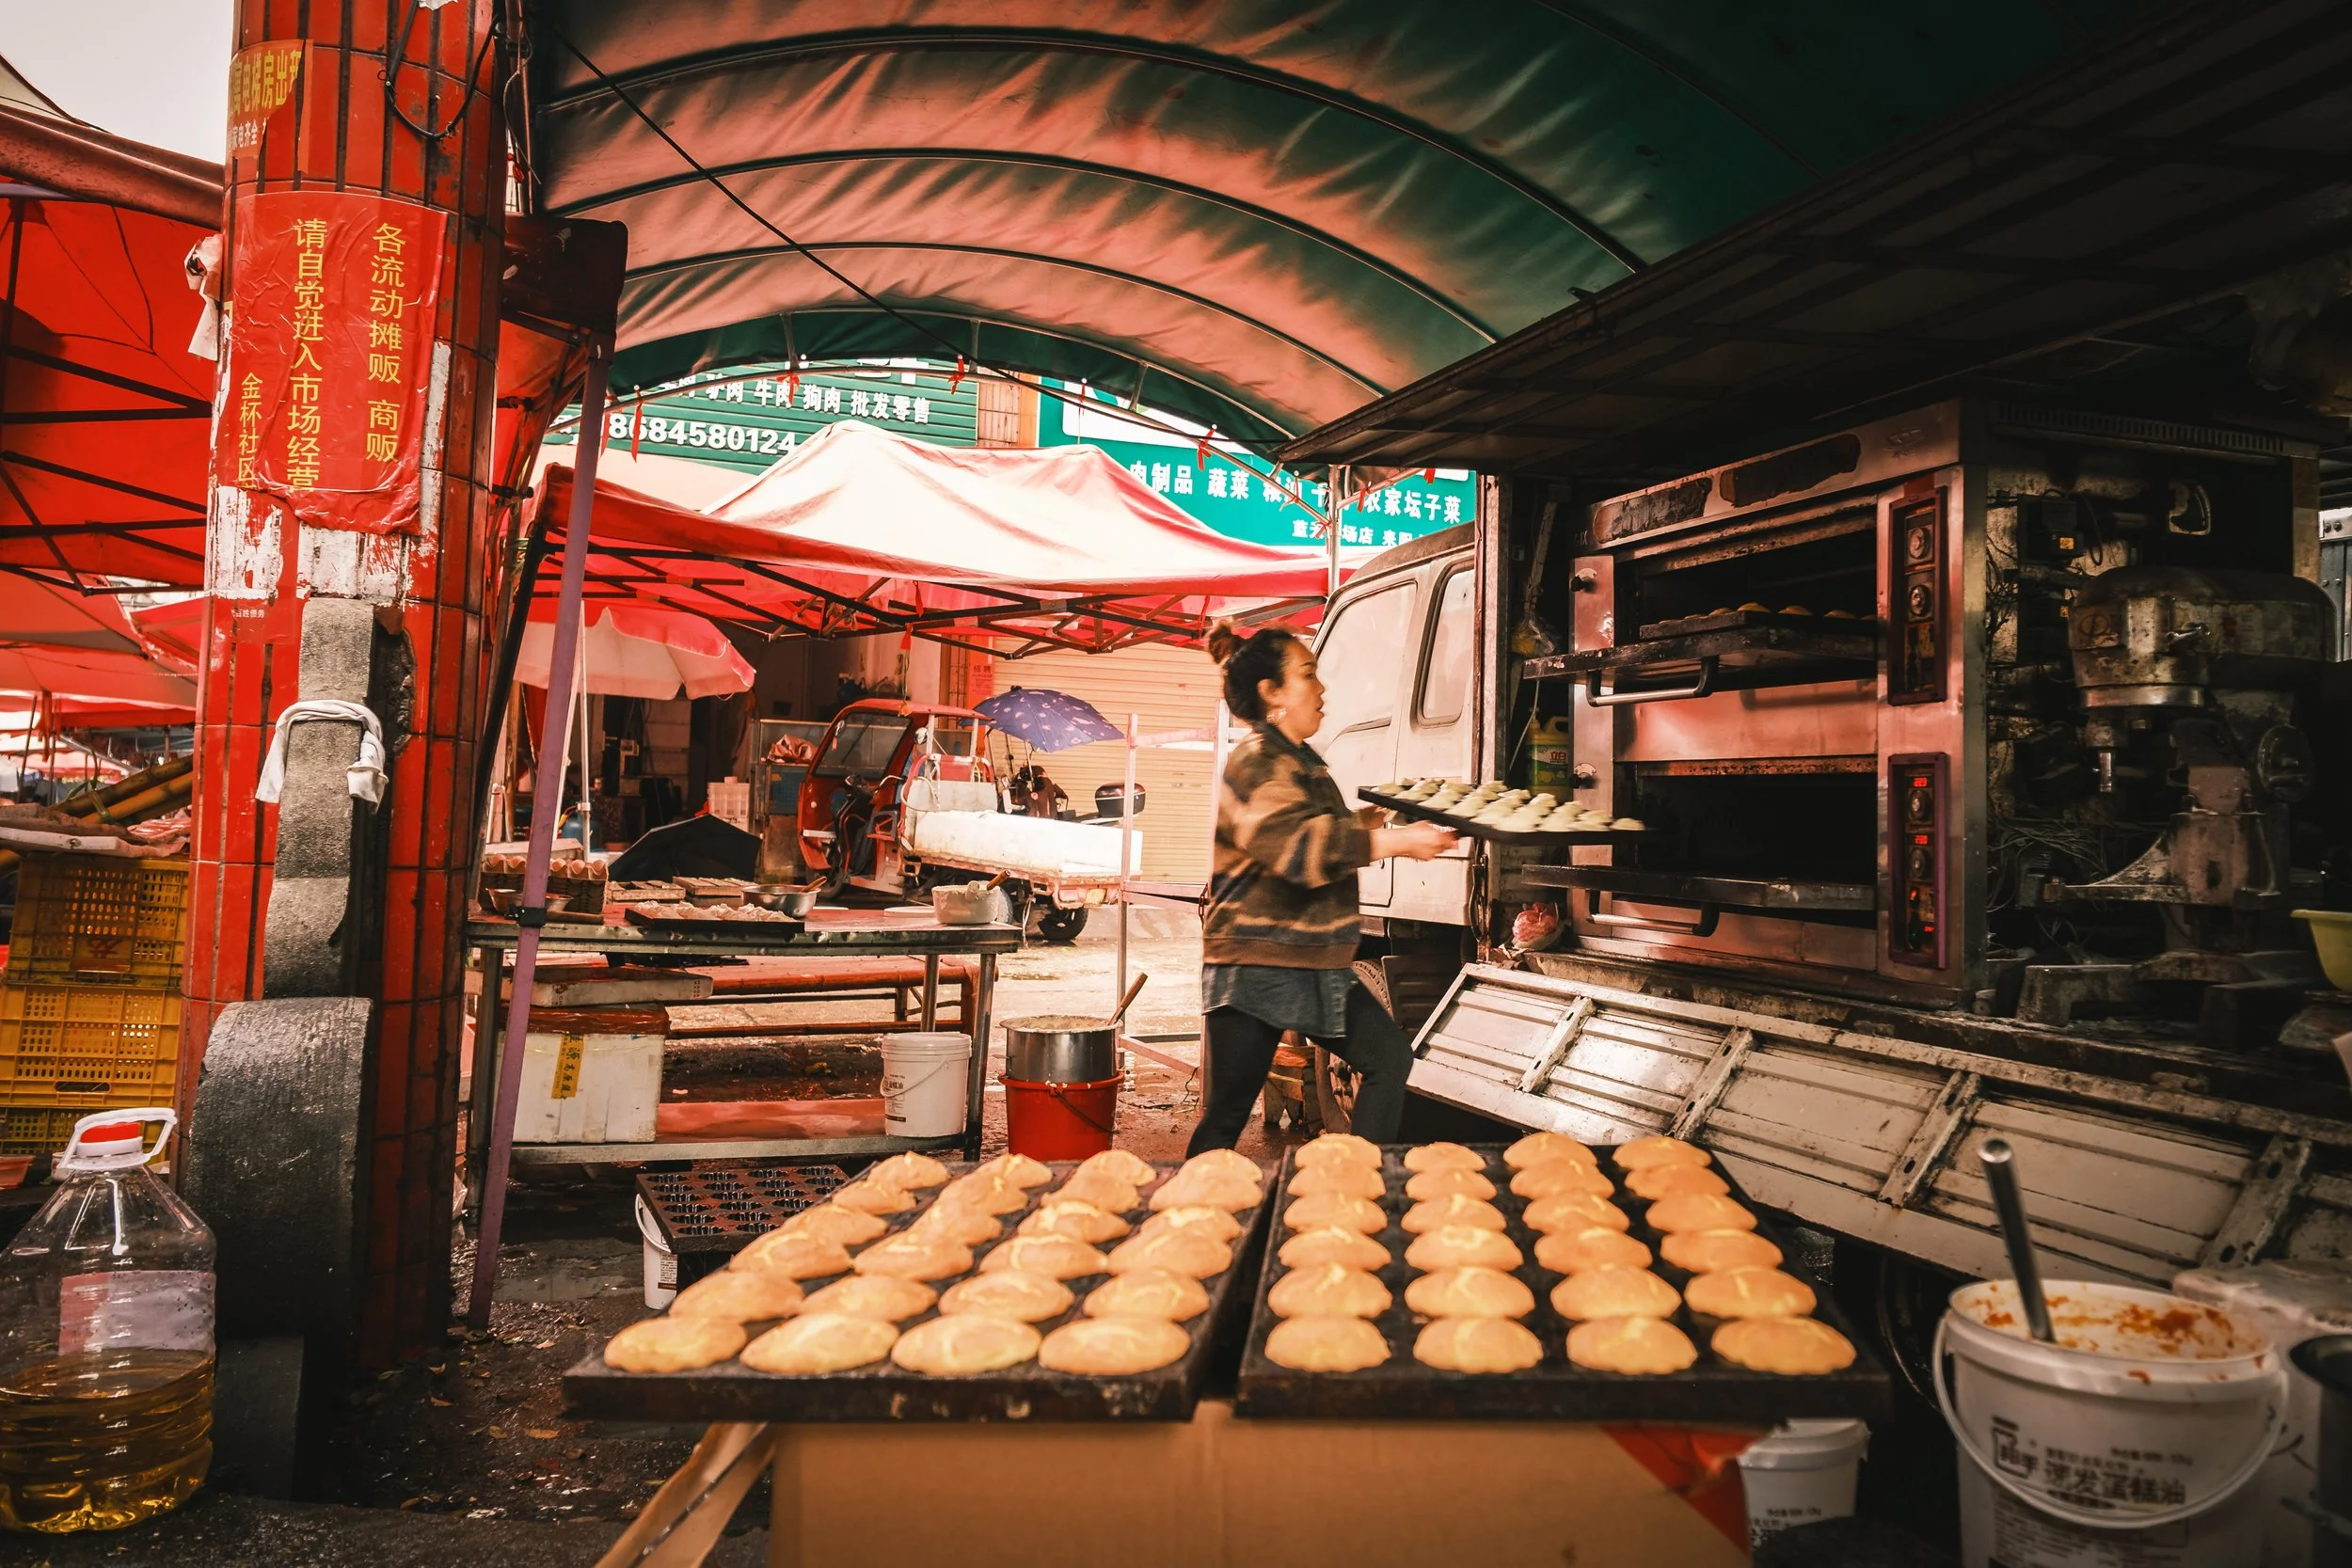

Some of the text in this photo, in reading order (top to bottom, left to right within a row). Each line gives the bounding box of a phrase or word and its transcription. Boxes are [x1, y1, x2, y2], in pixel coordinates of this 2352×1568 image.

[286, 217, 328, 493] 请自觉进入市场经营
[365, 222, 406, 463] 各流动摊贩 商贩
[237, 372, 263, 490] 金杯社区
[600, 411, 796, 454] 8684580124
[754, 378, 792, 408] 牛肉
[850, 389, 930, 423] 批发零售
[1129, 461, 1193, 495] 肉制品
[1208, 468, 1249, 499] 蔬菜
[1364, 487, 1462, 524] 农家坛子菜
